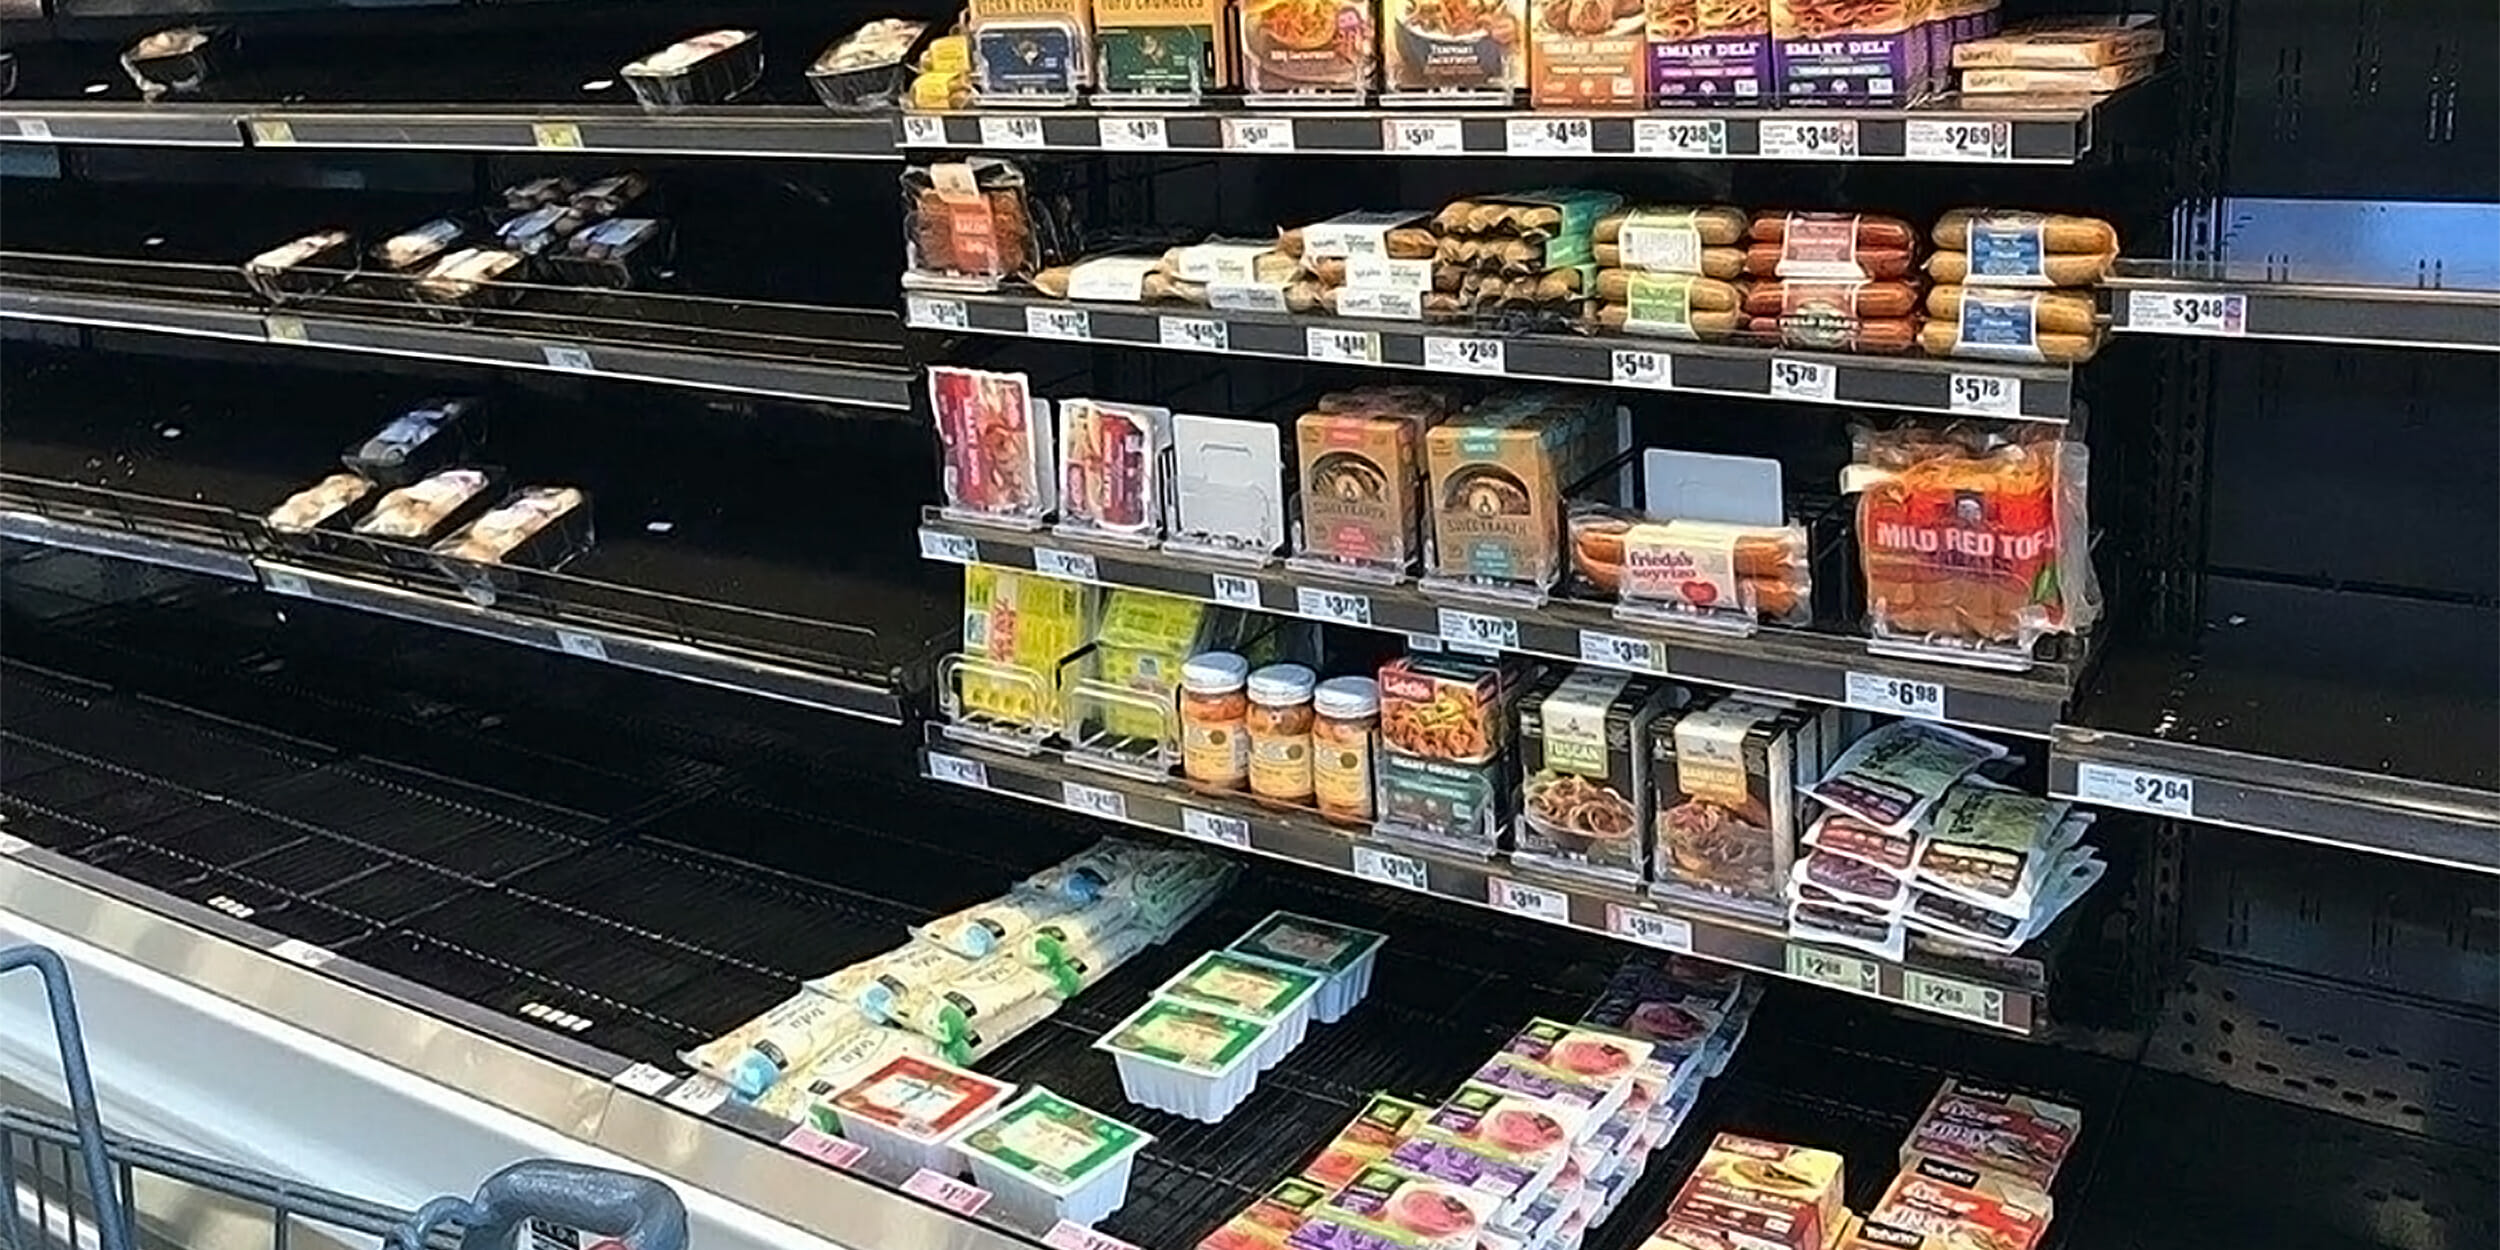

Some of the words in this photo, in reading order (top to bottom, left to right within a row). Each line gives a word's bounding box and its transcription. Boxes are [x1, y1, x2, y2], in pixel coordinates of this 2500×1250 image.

[1657, 44, 1712, 57] SMART
[1717, 42, 1759, 56] DELI
[1785, 42, 1844, 56] SMART
[1849, 40, 1896, 54] DELI
[1668, 125, 1708, 148] $238
[1797, 126, 1839, 150] $348
[1946, 126, 1990, 151] $269
[2173, 298, 2223, 324] $348
[1776, 362, 1818, 387] $578
[1956, 377, 2000, 402] $578
[1876, 520, 1938, 552] MILD
[1945, 526, 1995, 557] RED
[1630, 551, 1694, 568] frieda's
[1632, 567, 1697, 582] soyrizo
[1888, 680, 1937, 706] $698
[2135, 776, 2189, 804] $264
